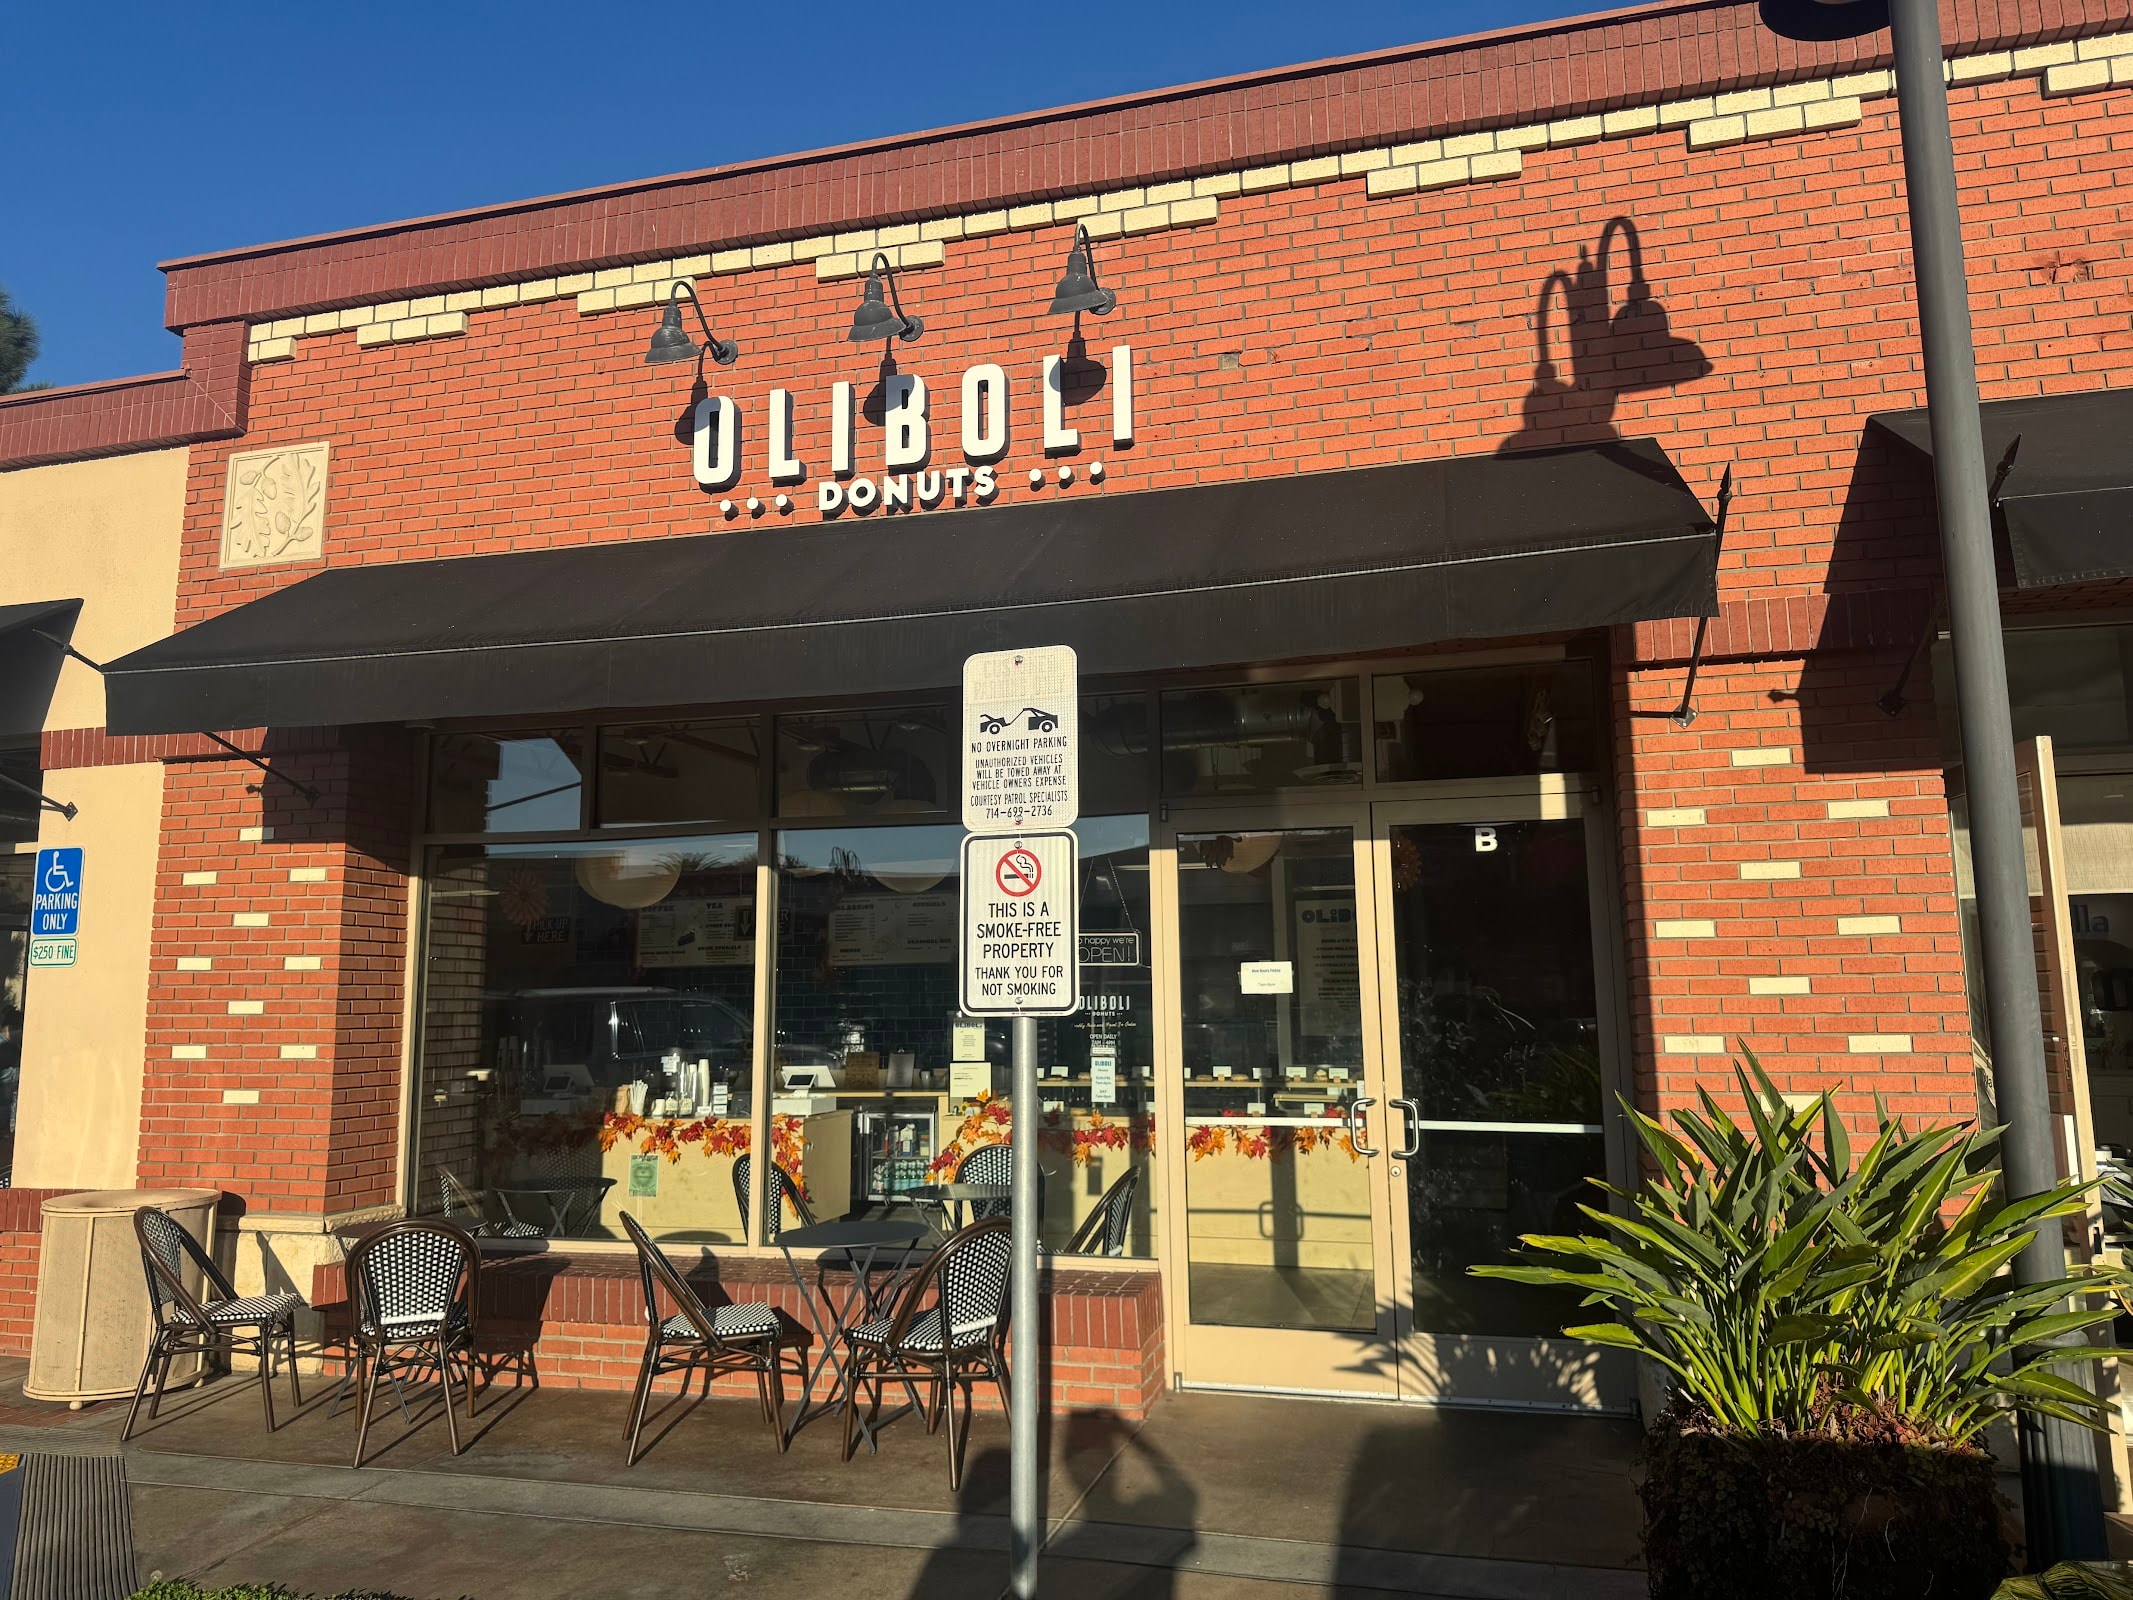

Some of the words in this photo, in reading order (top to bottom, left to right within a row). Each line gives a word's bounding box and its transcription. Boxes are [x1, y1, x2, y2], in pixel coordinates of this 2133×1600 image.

[694, 345, 1132, 484] OLIBOLI
[819, 465, 995, 511] DONUTS
[971, 742, 982, 753] NO
[986, 739, 1030, 752] OVERNIGHT
[1033, 736, 1067, 749] PARKING
[975, 756, 1027, 768] UNAUTHORIZED
[1030, 754, 1063, 765] VEHICLES
[976, 770, 992, 779] WILL
[995, 769, 1004, 778] BE
[1007, 767, 1030, 777] TOWED
[1033, 766, 1051, 776] AWAY
[1053, 765, 1062, 774] AT
[972, 779, 1000, 790] VEHICLE
[1003, 777, 1032, 789] OWNERS
[1035, 775, 1067, 787] EXPENSE
[970, 794, 1001, 806] COURTESY
[1004, 793, 1027, 805] PATROL
[1029, 790, 1068, 803] SPECIALISTS
[986, 805, 1053, 819] 714-699-2736
[1474, 827, 1499, 852] B
[35, 892, 78, 911] PARKING
[706, 902, 723, 910] TEA
[988, 902, 1017, 917] THIS
[1023, 901, 1035, 917] IS
[1040, 901, 1050, 916] A
[42, 913, 68, 931] ONLY
[976, 921, 1062, 939] SMOKE-FREE
[537, 930, 567, 943] HERE
[1084, 936, 1111, 946] happy
[1113, 937, 1135, 945] we're
[32, 945, 54, 960] $250
[57, 944, 74, 959] FINE
[983, 942, 1054, 959] PROPERTY
[1079, 946, 1131, 962] OPEN!
[975, 966, 1010, 980] THANK
[1014, 966, 1037, 979] YOU
[1042, 965, 1064, 978] FOR
[981, 983, 1003, 996] NOT
[1007, 982, 1056, 996] SMOKING
[1079, 995, 1130, 1010] OLIBOLI
